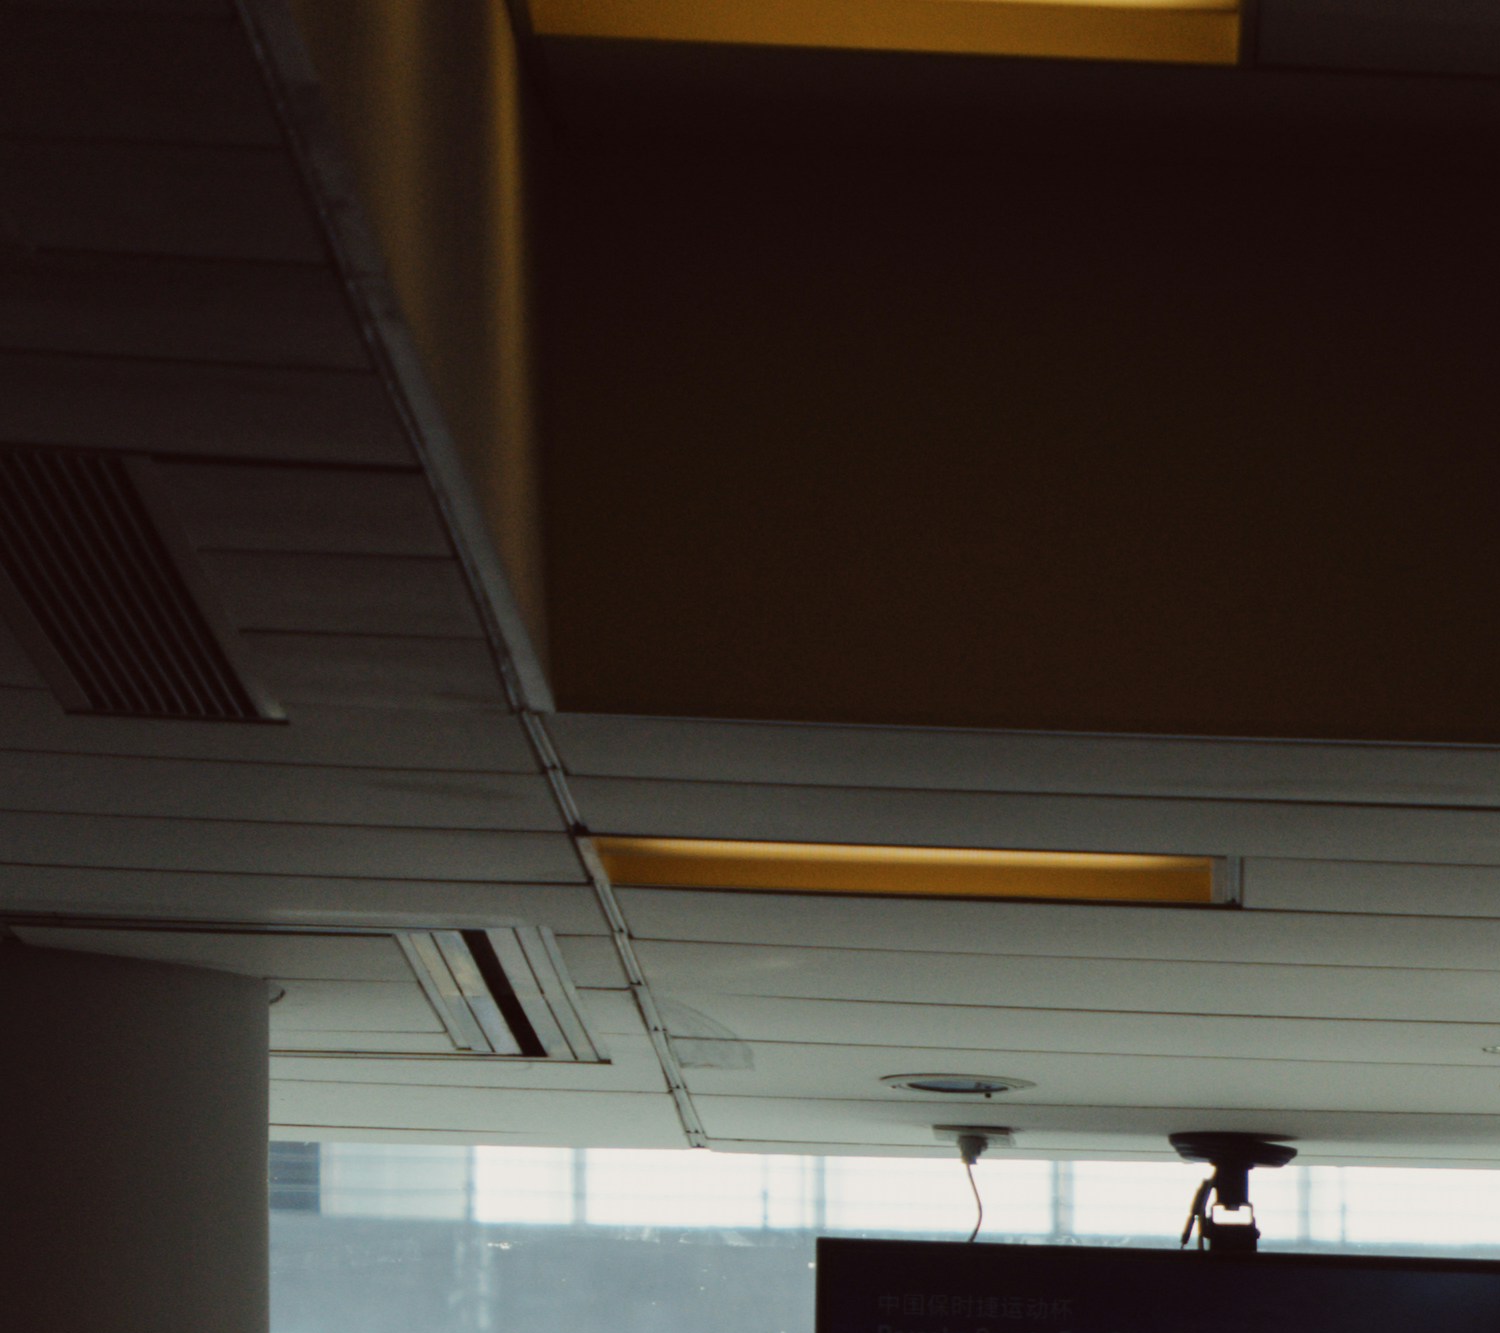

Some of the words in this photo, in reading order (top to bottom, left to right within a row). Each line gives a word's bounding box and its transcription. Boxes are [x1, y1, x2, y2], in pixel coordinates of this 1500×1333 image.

[877, 1293, 1074, 1321] 中国保时捷运动杯
